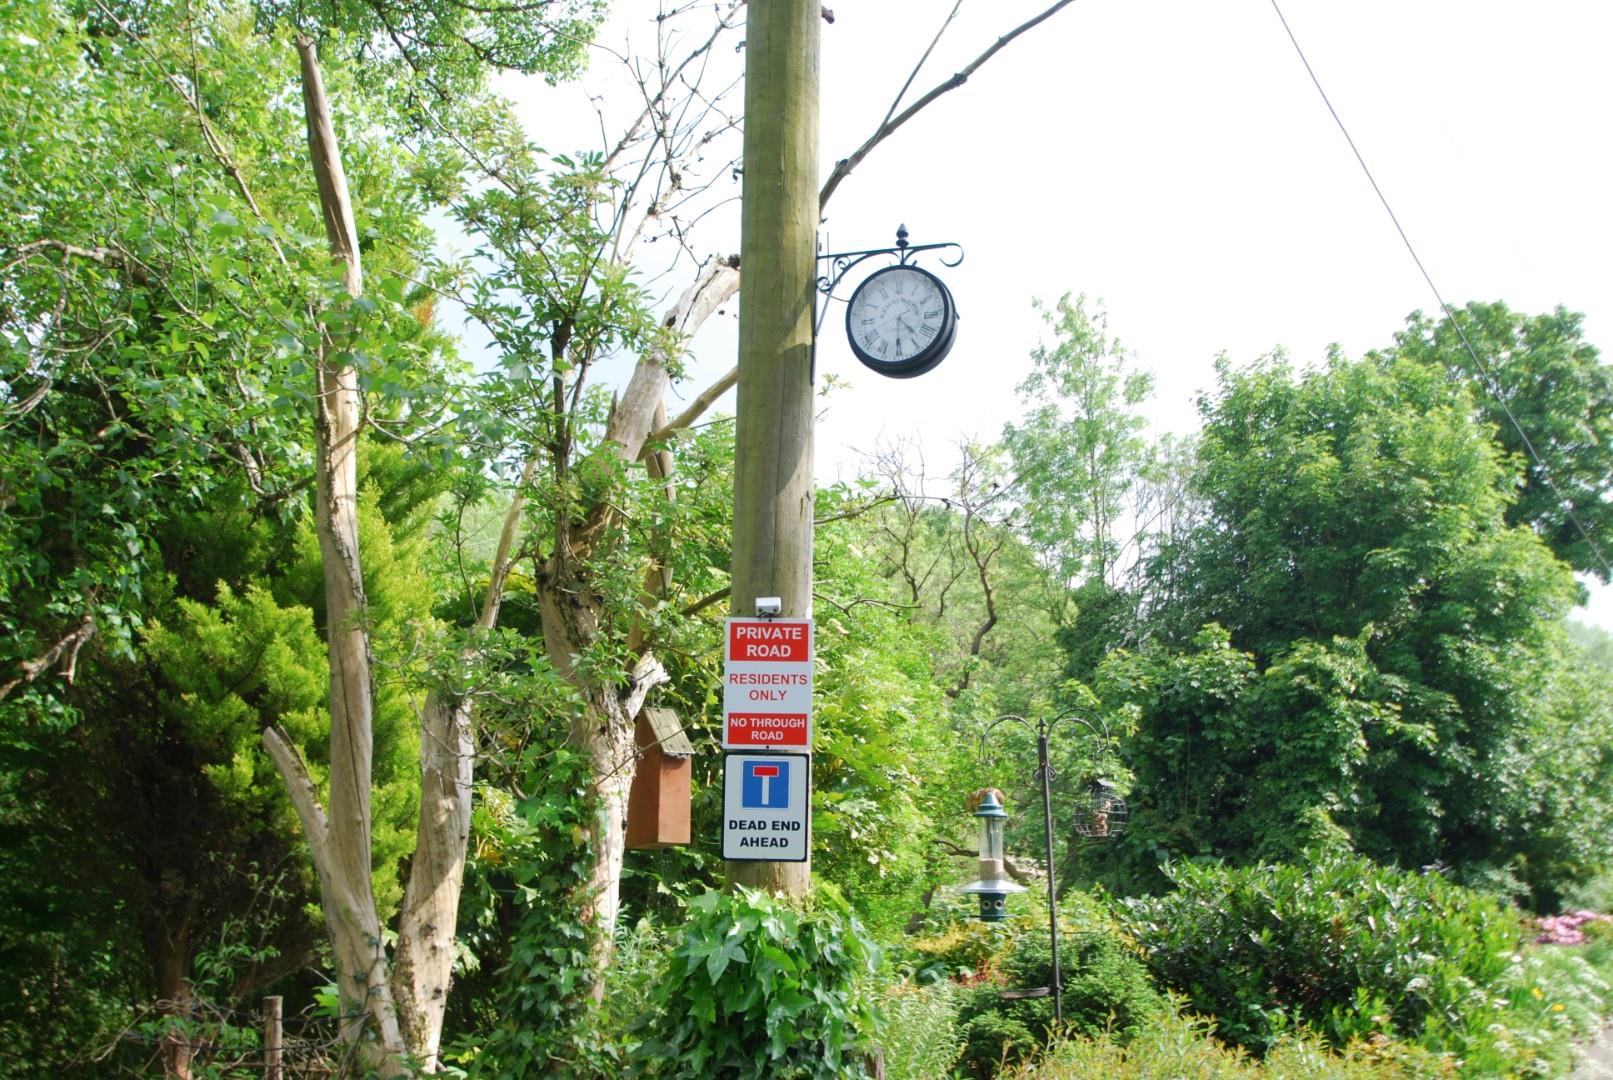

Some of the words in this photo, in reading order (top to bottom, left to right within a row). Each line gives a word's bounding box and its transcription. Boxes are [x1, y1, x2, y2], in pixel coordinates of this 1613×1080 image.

[736, 626, 802, 640] PRIVATE
[746, 644, 792, 657] ROAD
[729, 673, 808, 685] RESIDENTS
[749, 689, 787, 701] ONLY
[730, 718, 747, 727] NO
[750, 718, 805, 728] THROUGH
[751, 730, 784, 740] ROAD
[728, 819, 767, 831] DEAD
[771, 820, 801, 831] END
[739, 836, 789, 848] AHEAD
